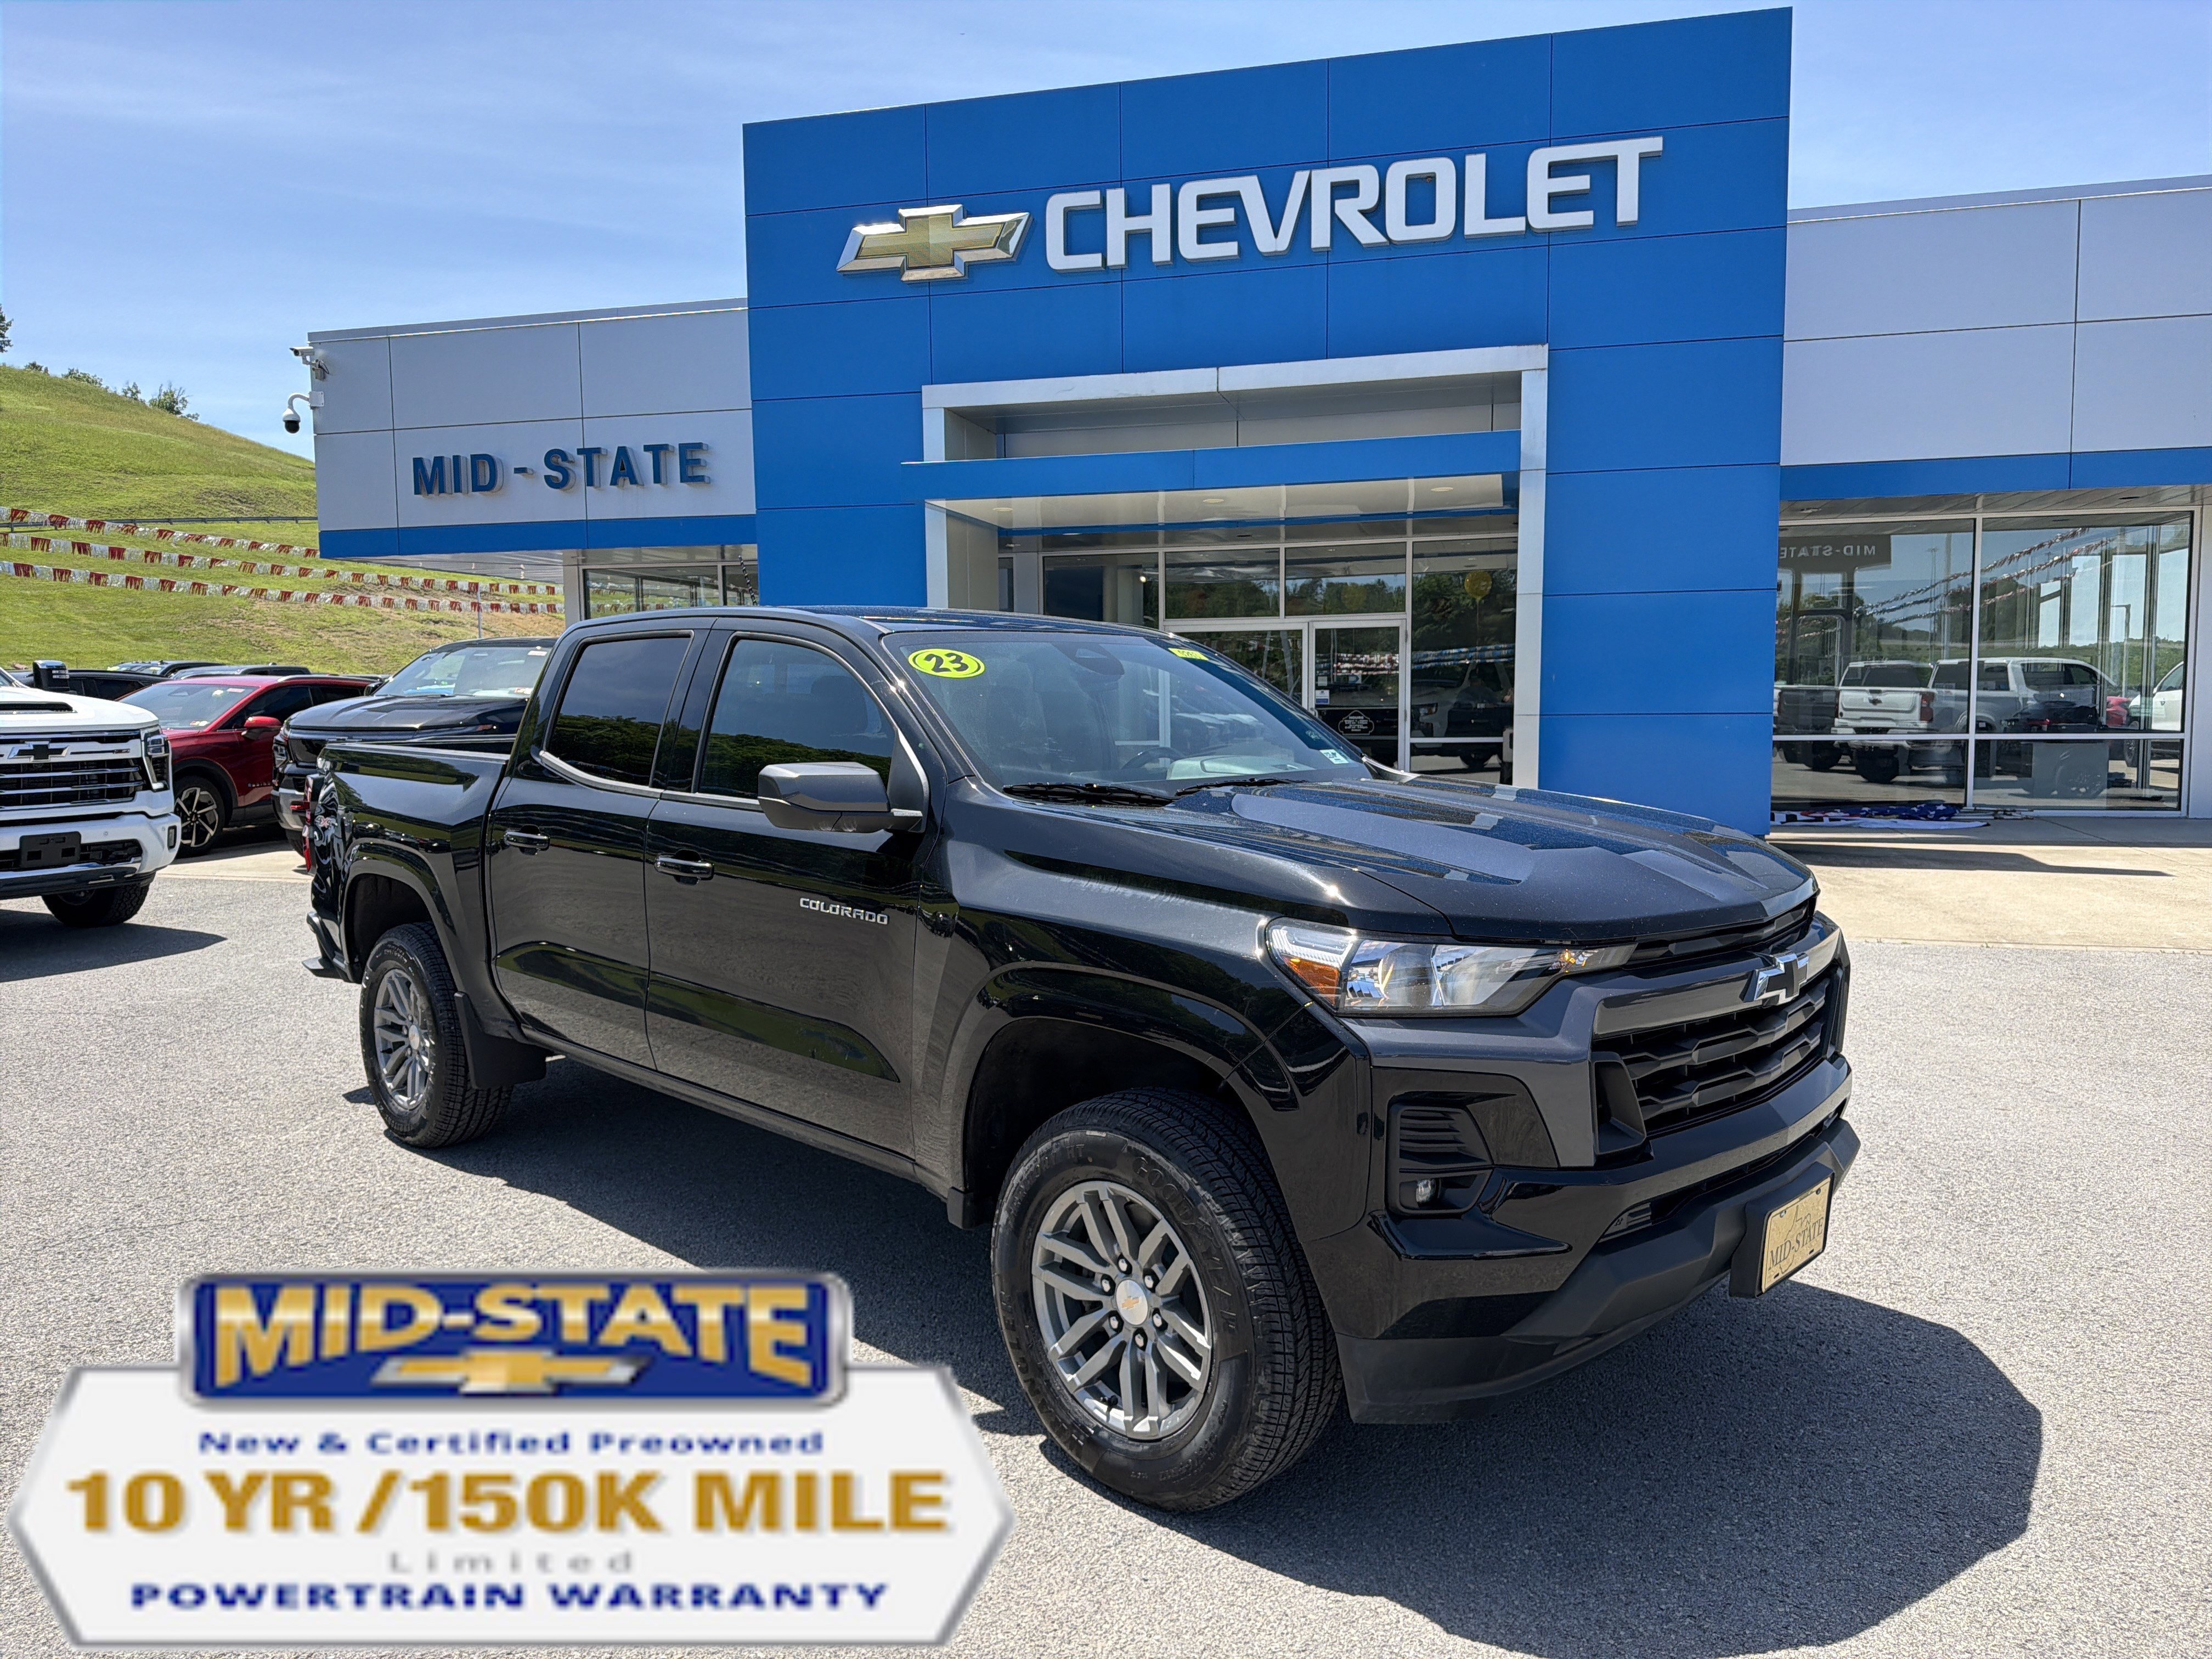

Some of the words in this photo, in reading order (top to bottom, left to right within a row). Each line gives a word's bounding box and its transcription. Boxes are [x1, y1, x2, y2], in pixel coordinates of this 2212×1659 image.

[1046, 136, 1663, 272] CHEVROLET
[924, 653, 969, 673] 23
[800, 898, 889, 925] COLORADO
[1768, 1216, 1824, 1271] MID-STATE
